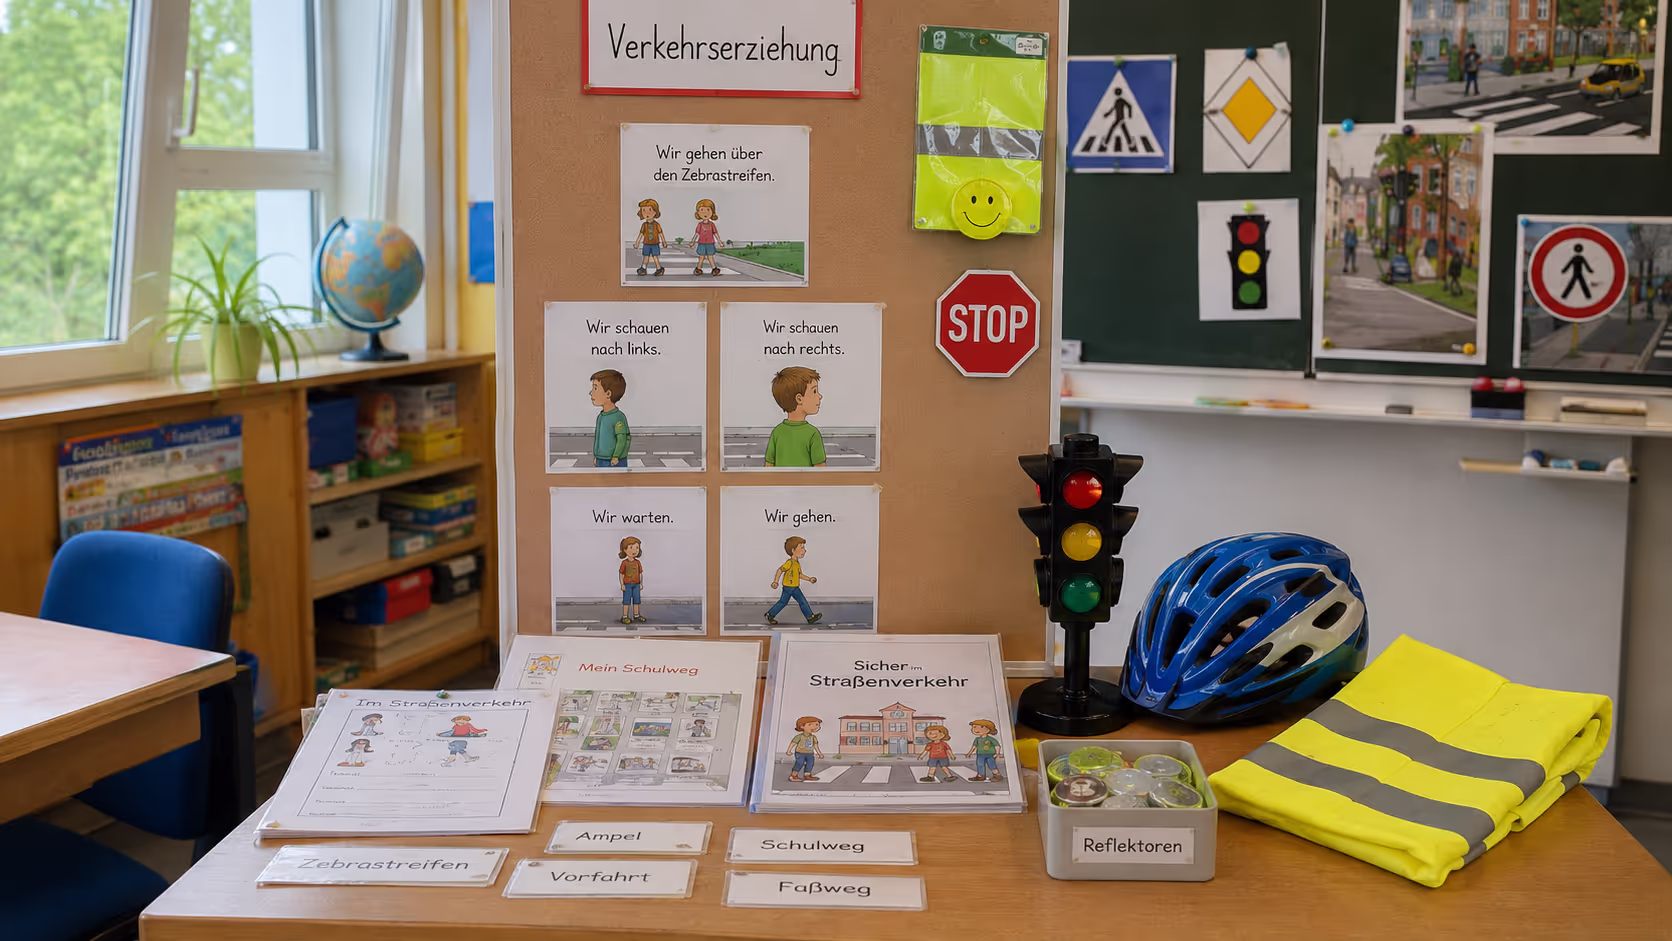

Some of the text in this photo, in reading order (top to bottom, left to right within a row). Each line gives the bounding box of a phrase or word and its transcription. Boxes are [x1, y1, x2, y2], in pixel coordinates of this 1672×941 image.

[608, 23, 839, 77] Verkehrserziehung
[656, 145, 763, 164] Wir gehen über
[653, 168, 775, 182] den Zebrastreifen.
[586, 319, 669, 335] Wir schauen
[763, 319, 839, 334] Wir schauen
[948, 303, 1028, 343] STOP
[591, 342, 661, 356] nach links.
[764, 342, 845, 356] nach rechts.
[592, 509, 674, 524] Wir warten.
[764, 508, 836, 528] Wir gehen.
[578, 663, 699, 677] Mein Schulweg
[854, 660, 908, 672] Sicher
[809, 674, 969, 689] Straßenverkehr
[356, 699, 382, 708] Im
[576, 832, 641, 843] Ampel
[761, 839, 865, 854] Schulweg
[1083, 837, 1183, 854] Reflektoren
[298, 858, 470, 871] Zebrastreifen
[551, 871, 652, 883] Vorfahrt
[779, 881, 871, 898] Faßweg
